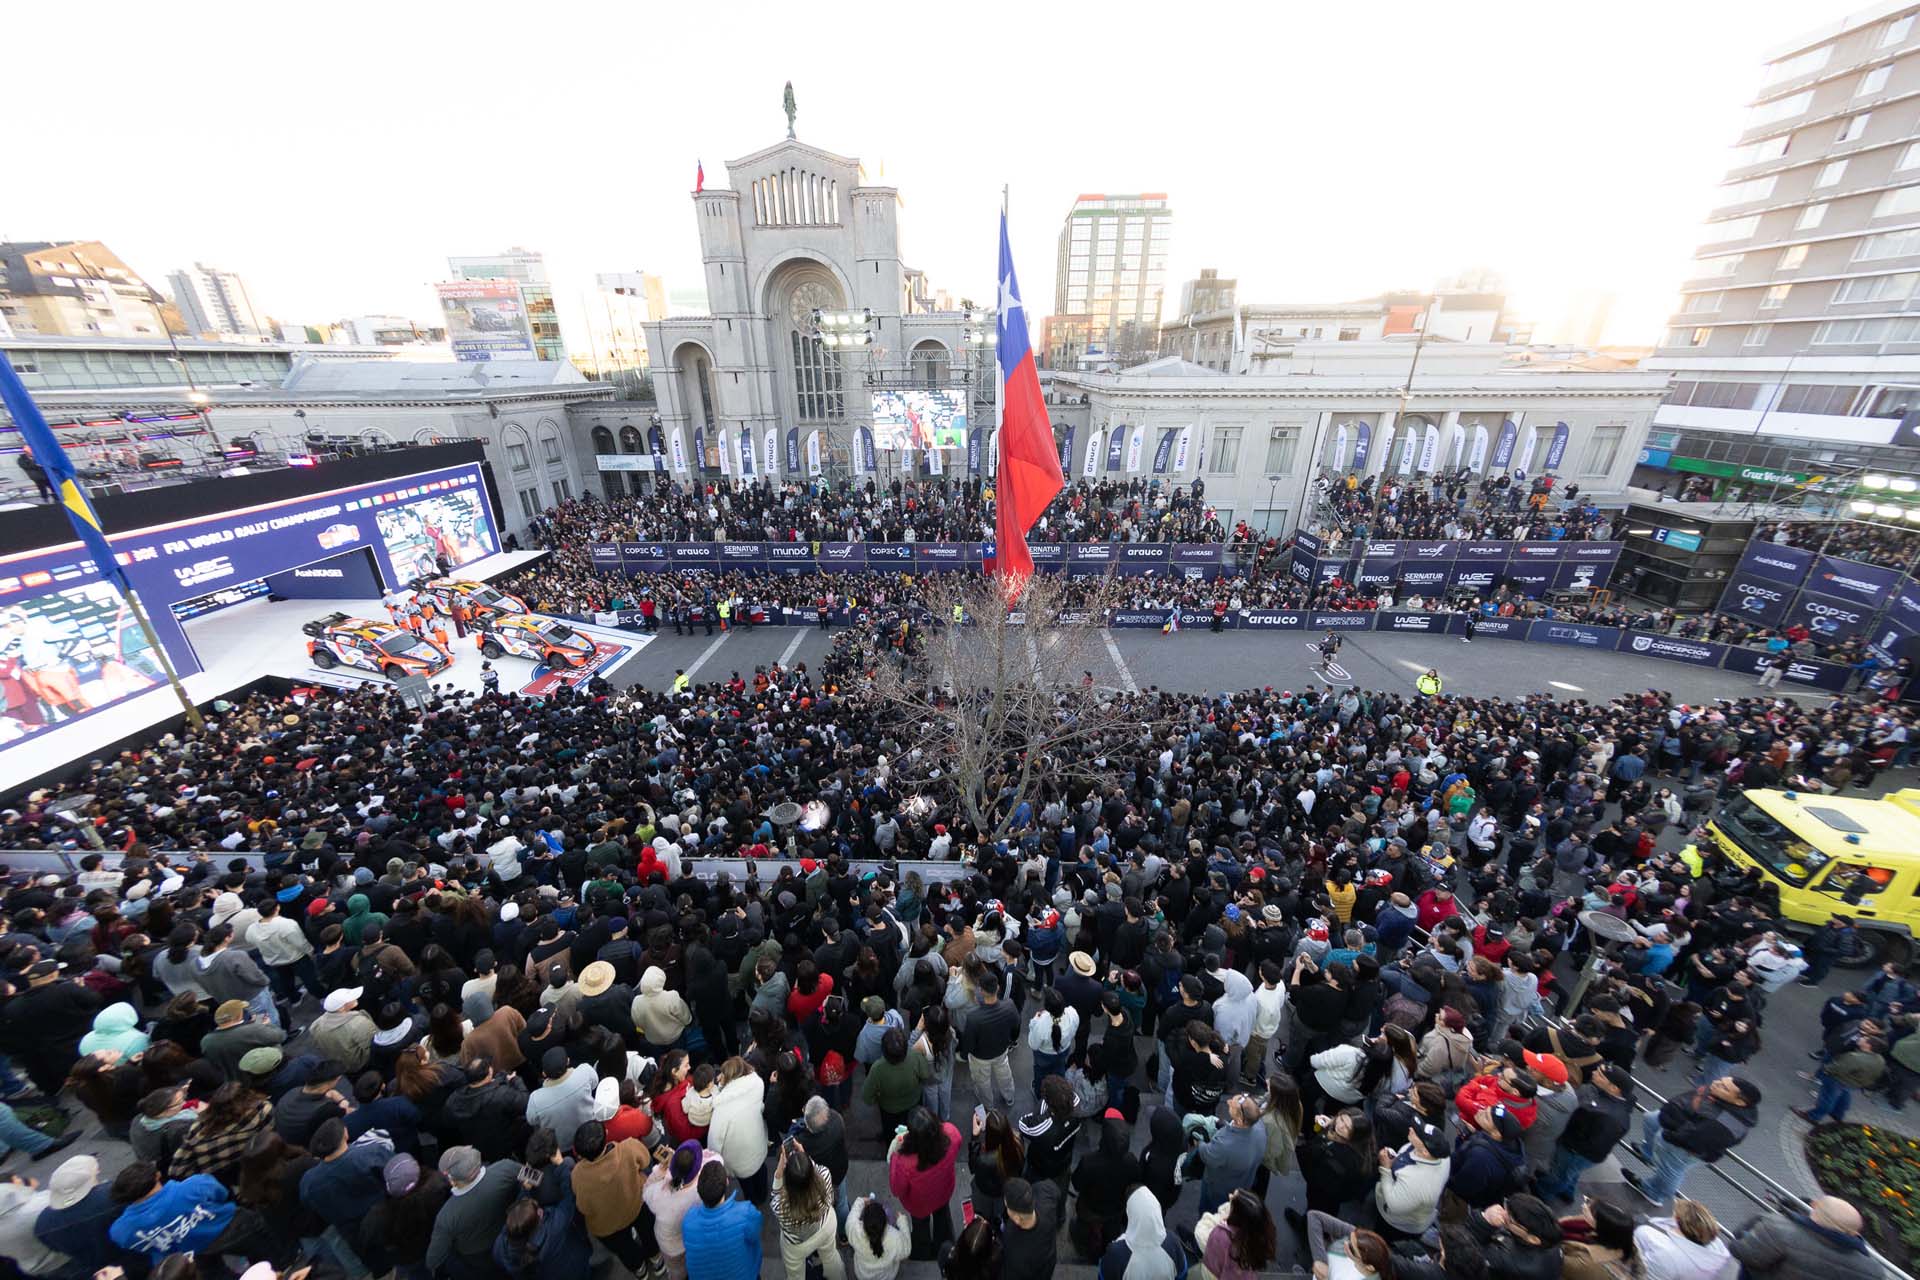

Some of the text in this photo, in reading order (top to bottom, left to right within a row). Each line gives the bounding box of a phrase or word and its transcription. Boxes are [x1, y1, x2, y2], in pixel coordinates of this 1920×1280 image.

[1741, 468, 1763, 480] Cruz
[187, 529, 235, 549] WORLD
[234, 521, 270, 539] RALLY
[270, 505, 342, 530] CHAMPIONSHIP
[1656, 529, 1667, 541] E
[677, 548, 710, 556] arauco
[1127, 548, 1163, 556] arauco
[1404, 572, 1444, 580] SERNATUR
[1738, 583, 1782, 602] COPEC
[1805, 602, 1860, 624] COPEC
[1249, 616, 1298, 625] arauco
